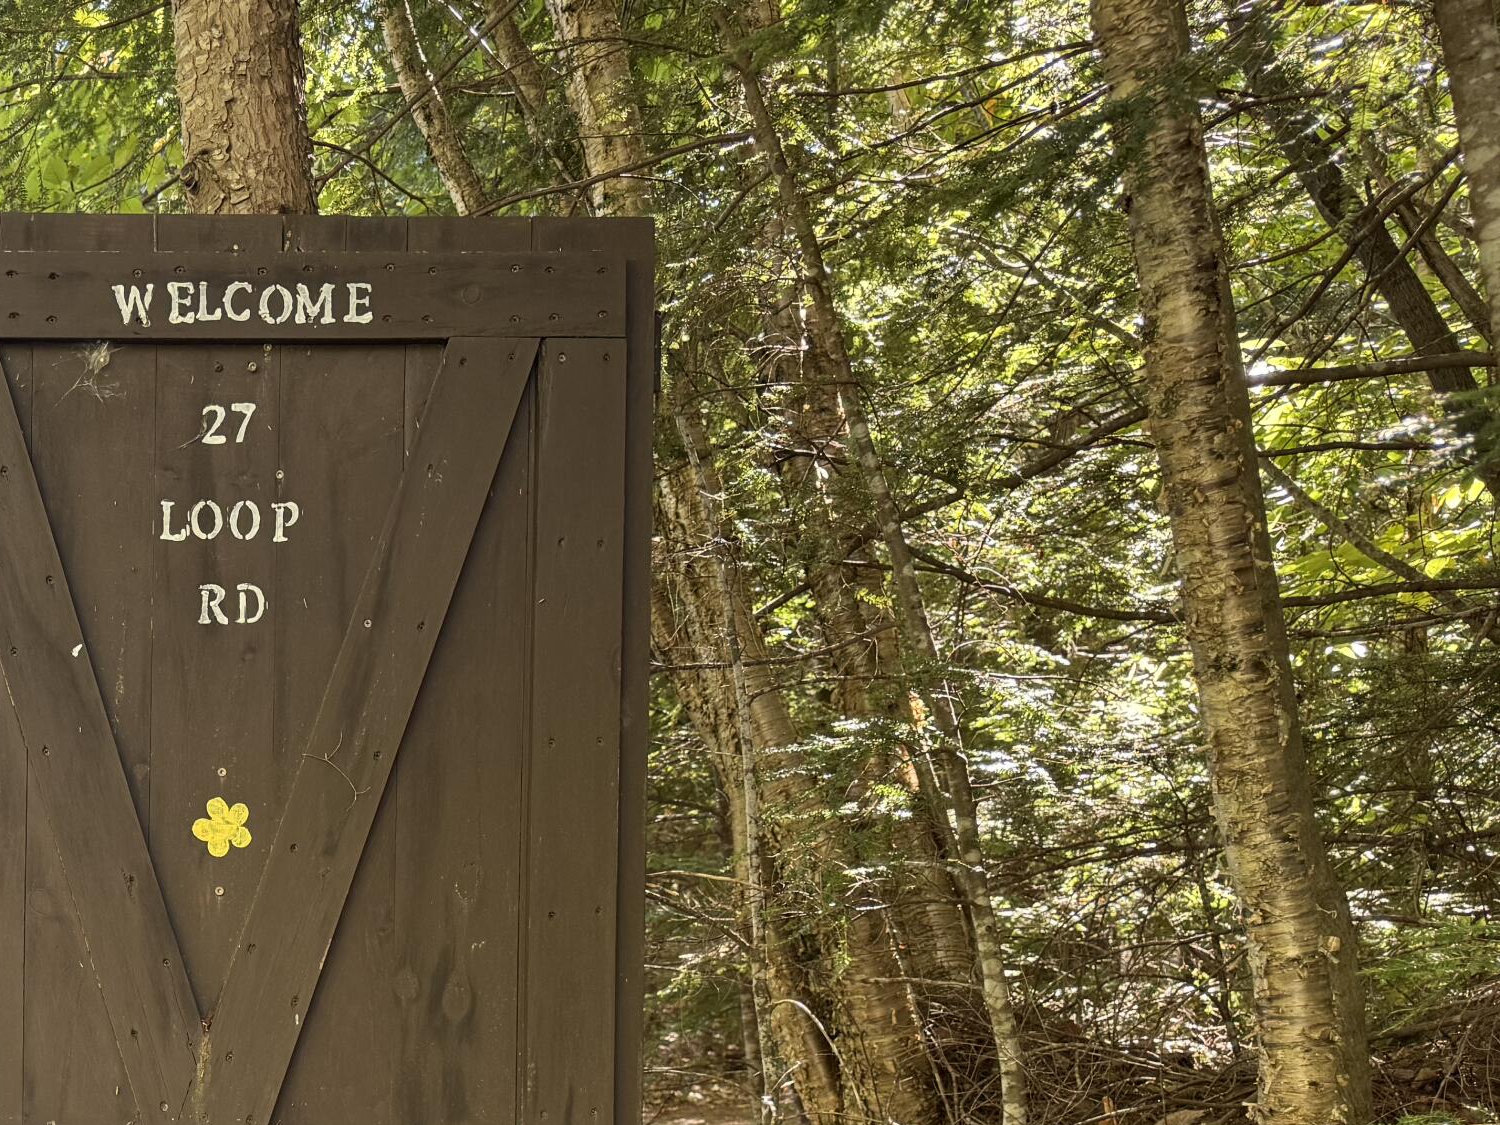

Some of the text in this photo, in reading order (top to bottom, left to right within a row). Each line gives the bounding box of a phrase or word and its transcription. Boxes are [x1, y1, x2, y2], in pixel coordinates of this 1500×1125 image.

[111, 281, 375, 327] WELCOME
[200, 402, 258, 445] 27
[159, 499, 300, 543] LOOP
[197, 582, 267, 625] RD
